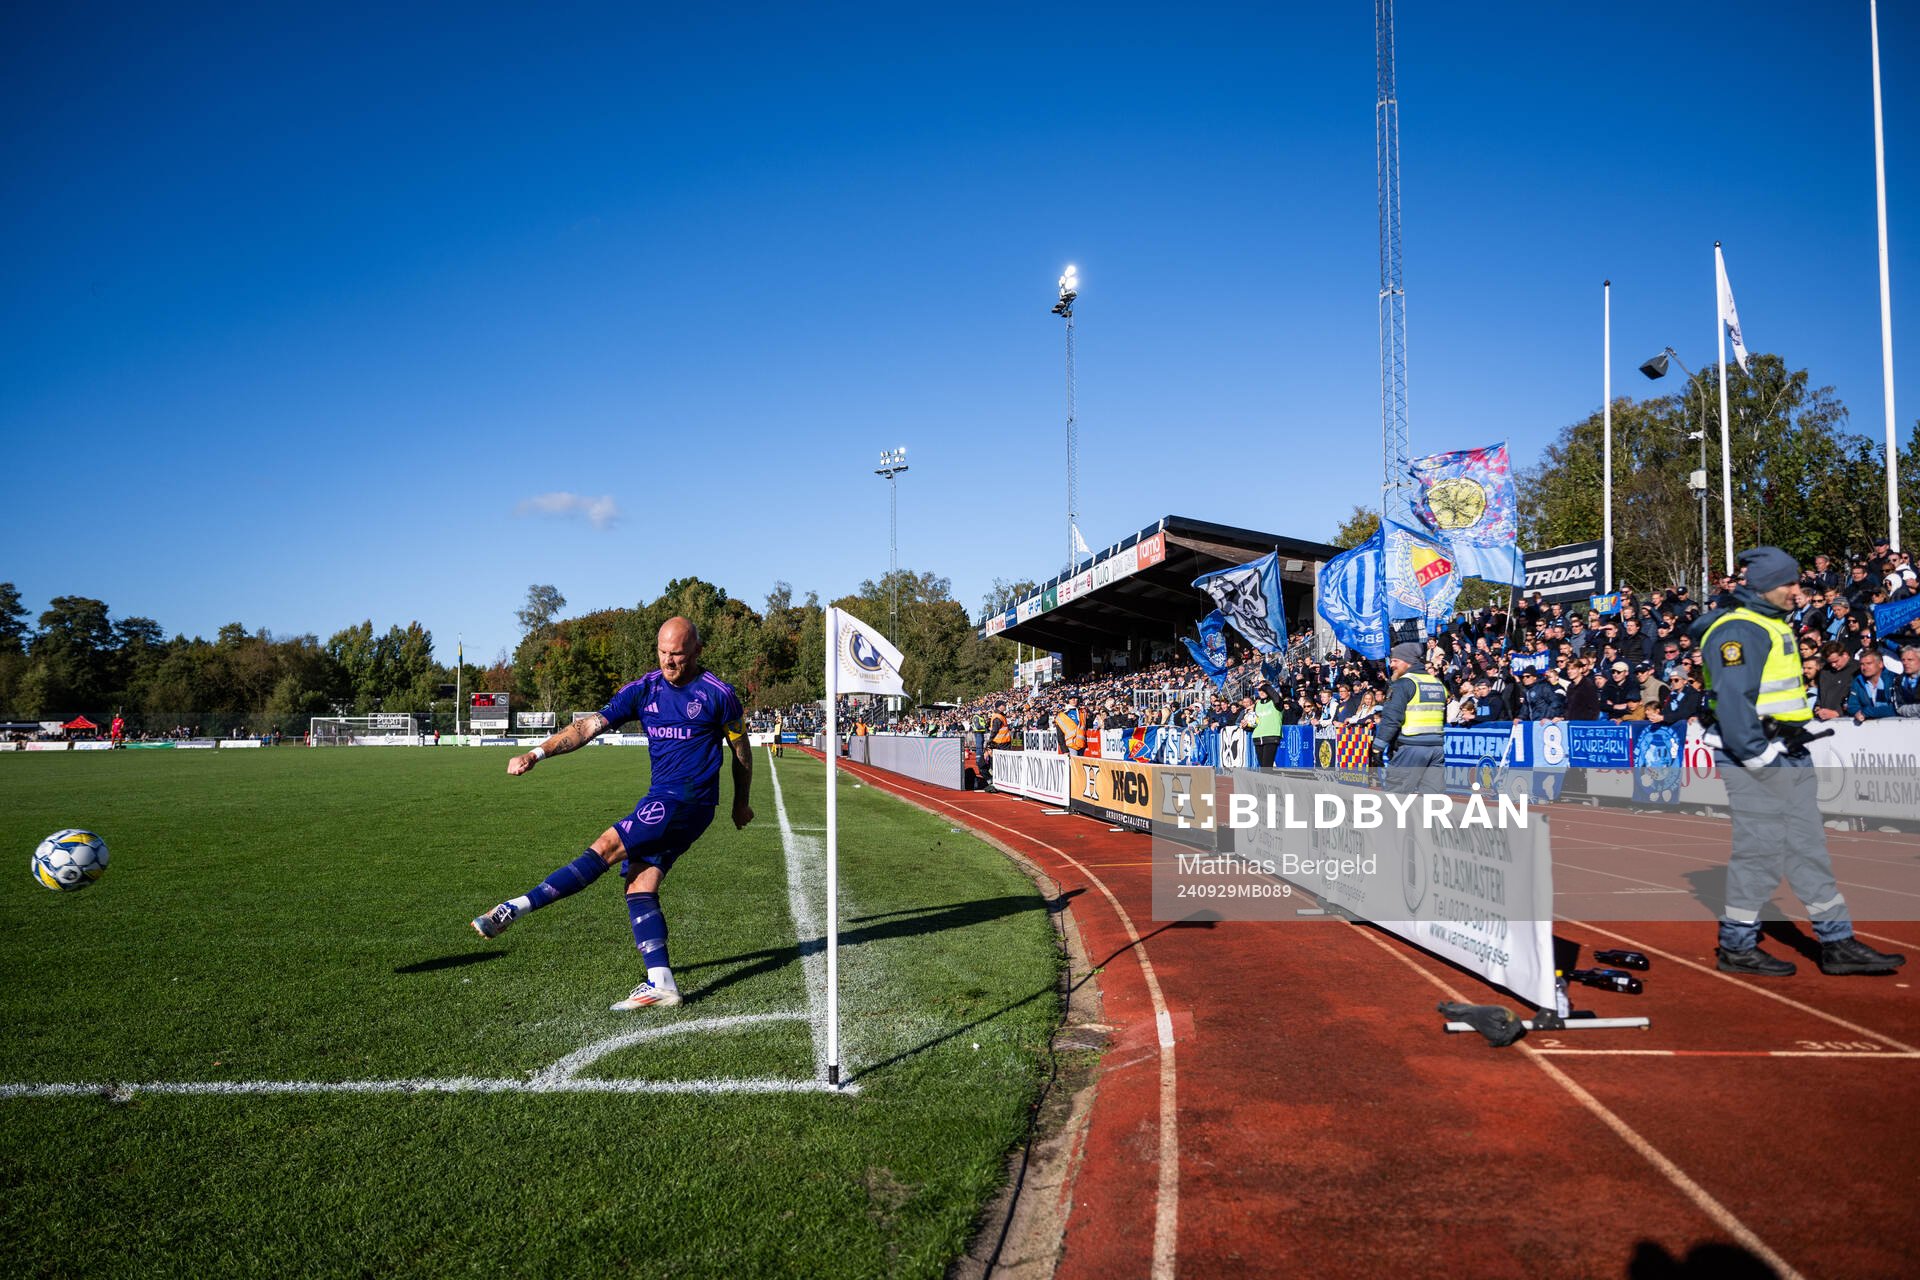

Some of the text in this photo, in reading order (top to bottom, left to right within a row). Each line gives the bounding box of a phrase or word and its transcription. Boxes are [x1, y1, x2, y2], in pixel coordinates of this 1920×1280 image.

[1525, 562, 1597, 587] TROAX
[1851, 748, 1917, 777] VÄRNAMO
[1105, 810, 1150, 829] SKRUVSPCIALISTEN
